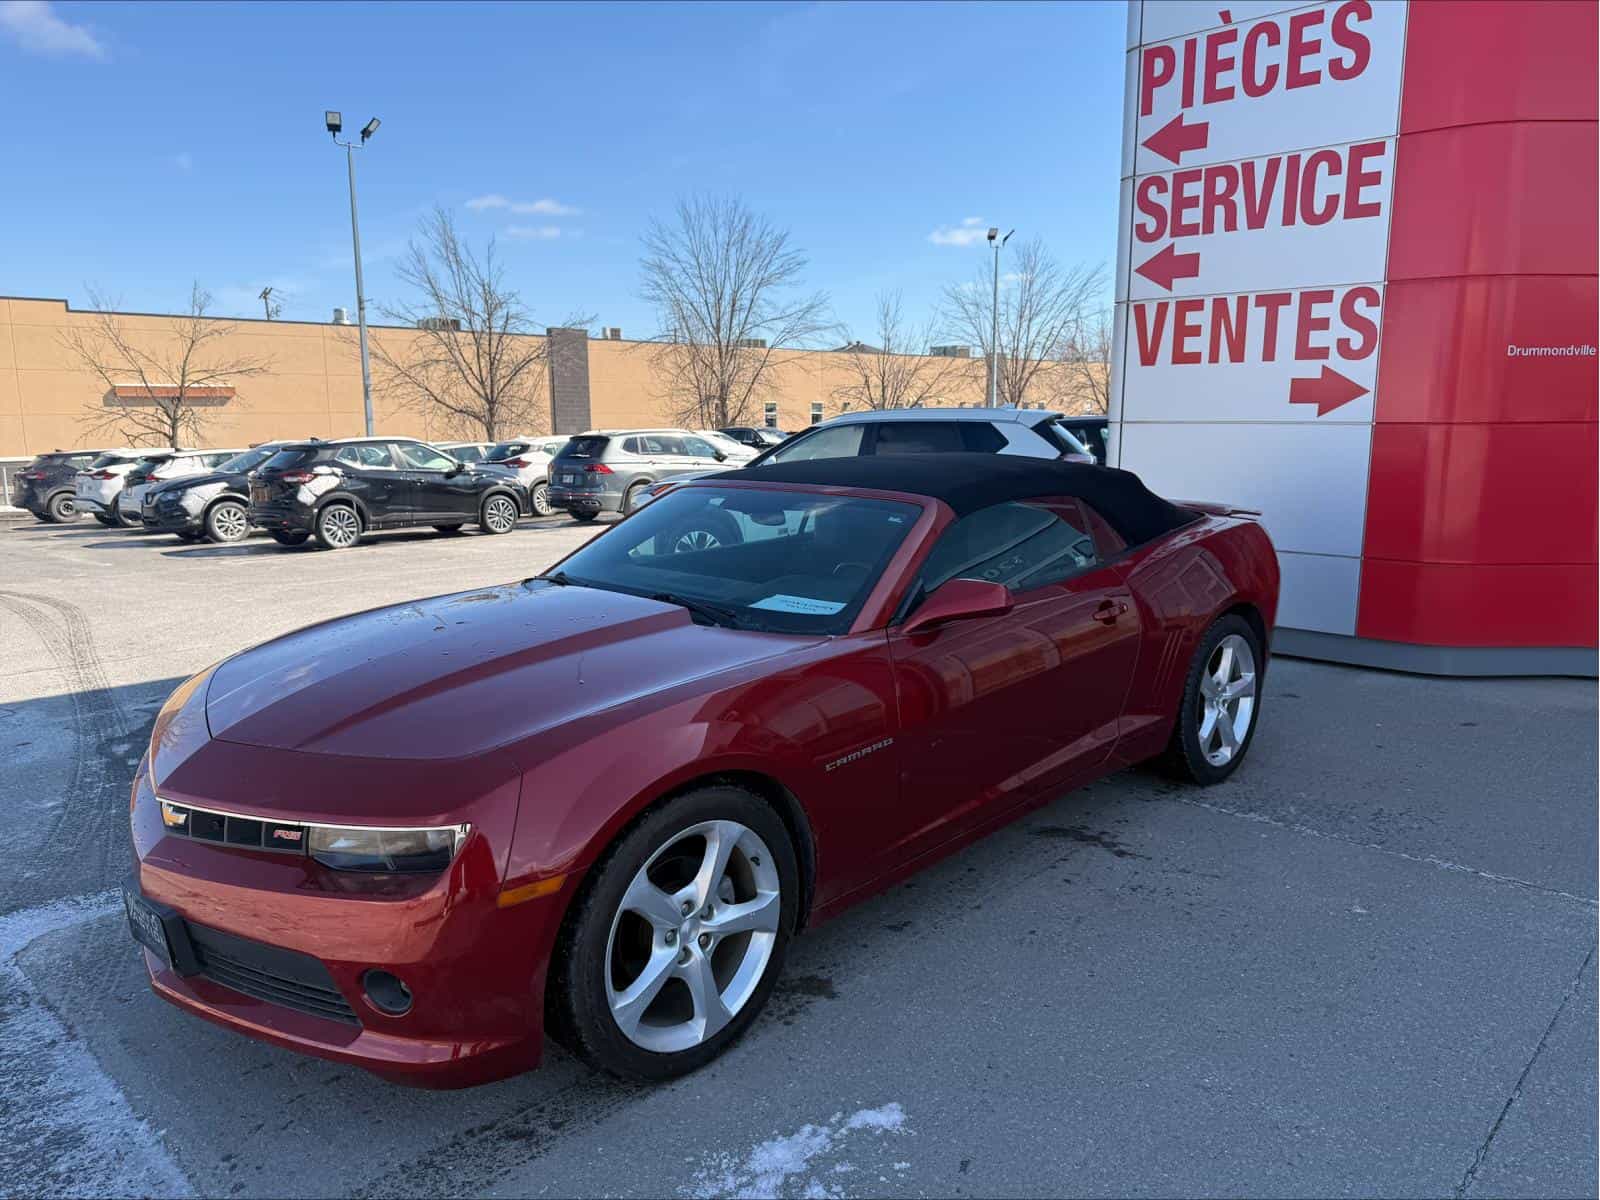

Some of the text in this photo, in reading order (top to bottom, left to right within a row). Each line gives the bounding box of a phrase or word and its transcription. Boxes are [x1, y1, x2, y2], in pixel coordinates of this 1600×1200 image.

[1141, 0, 1373, 116] PIÈCES
[1135, 141, 1387, 243] SERVICE
[1133, 287, 1380, 367] VENTES
[1507, 344, 1597, 357] Drummondville
